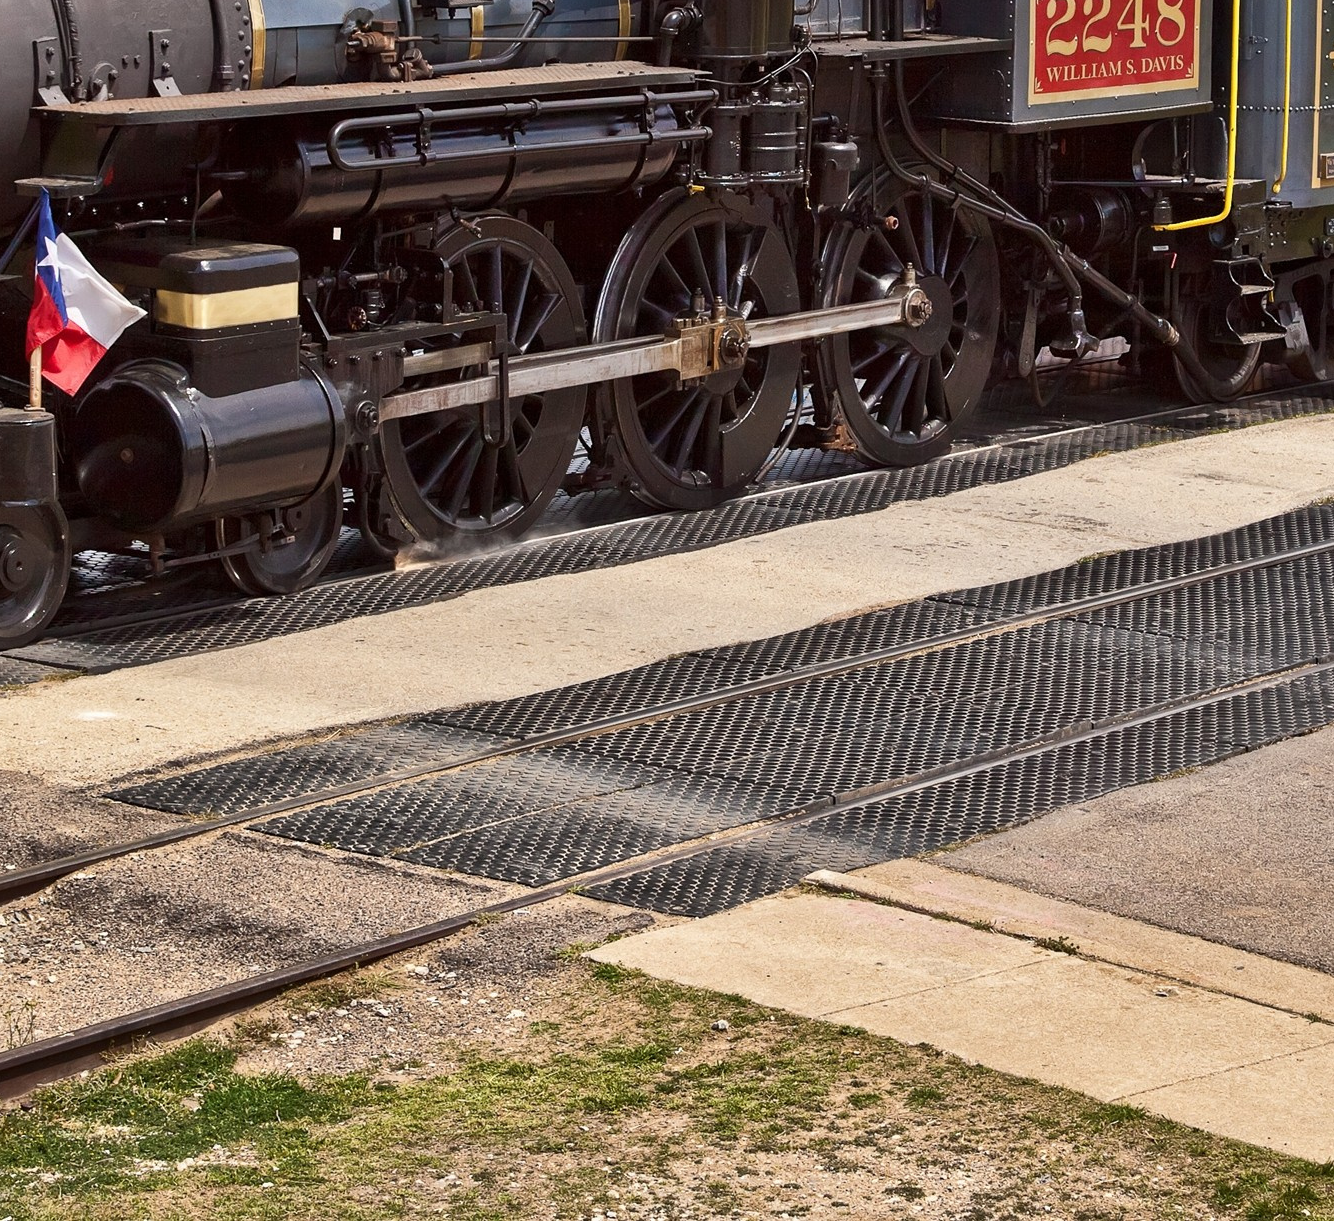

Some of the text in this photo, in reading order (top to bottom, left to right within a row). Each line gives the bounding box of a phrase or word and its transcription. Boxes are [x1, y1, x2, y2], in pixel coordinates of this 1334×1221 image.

[1046, 54, 1185, 83] WILLIAM S. DAVIS
